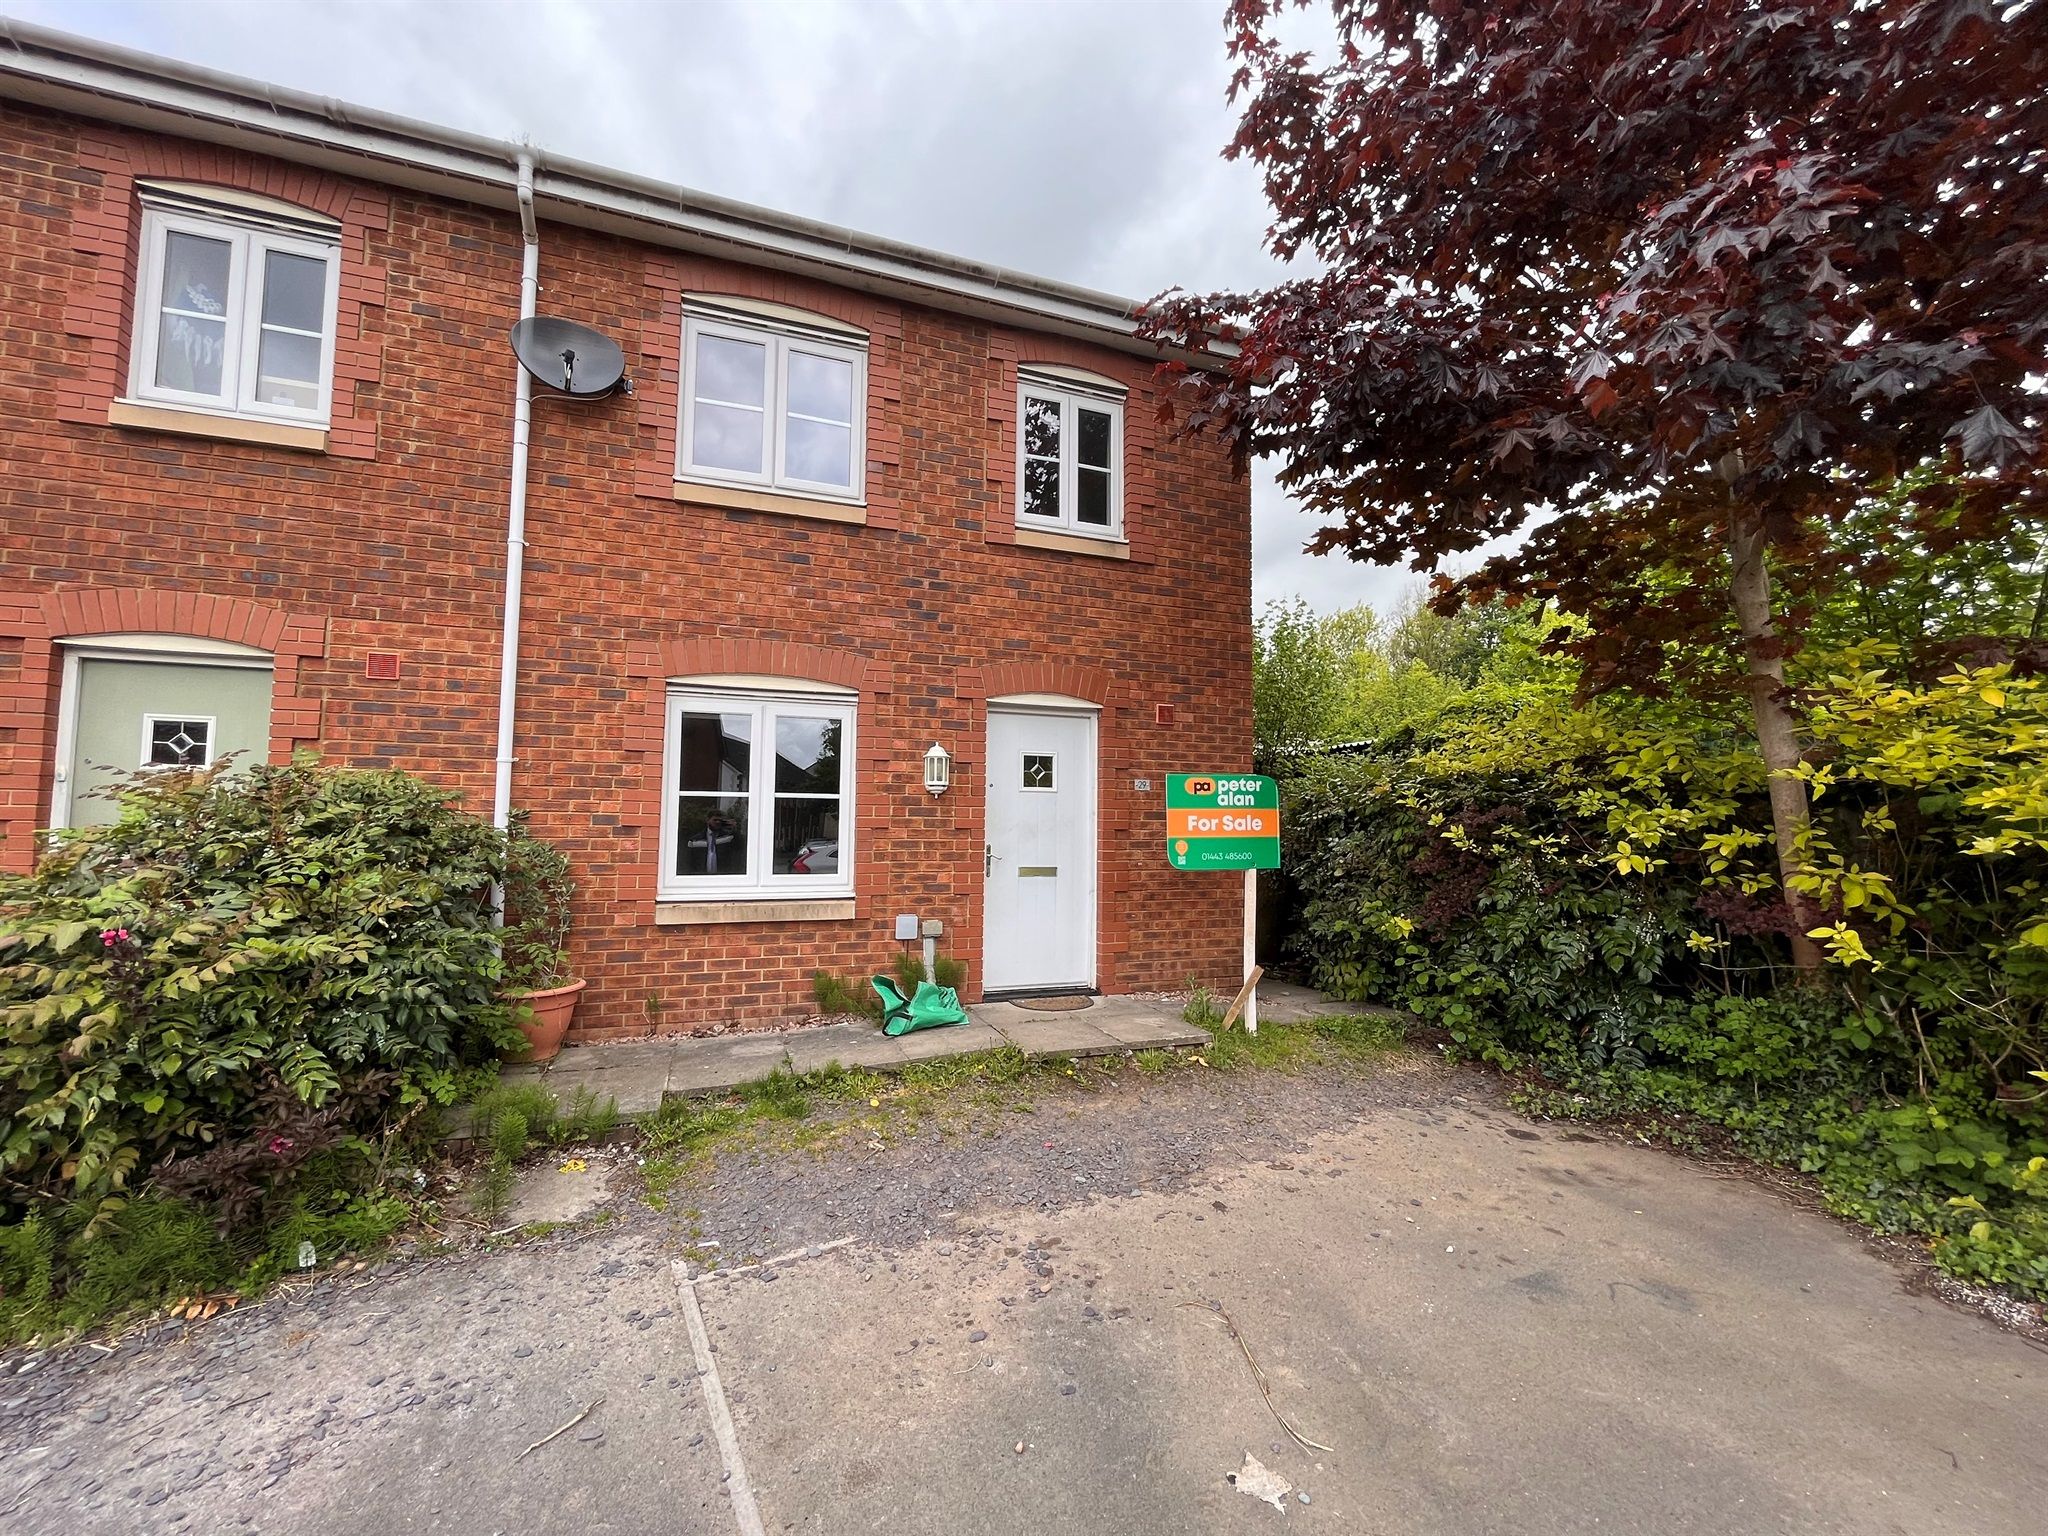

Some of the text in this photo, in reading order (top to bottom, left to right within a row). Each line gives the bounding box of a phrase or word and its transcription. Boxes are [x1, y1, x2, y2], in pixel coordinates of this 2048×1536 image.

[1194, 781, 1211, 794] pa
[1217, 778, 1262, 794] peter
[1217, 792, 1255, 806] alan
[1187, 815, 1263, 831] For Sale
[1202, 852, 1252, 861] 01443 485600
